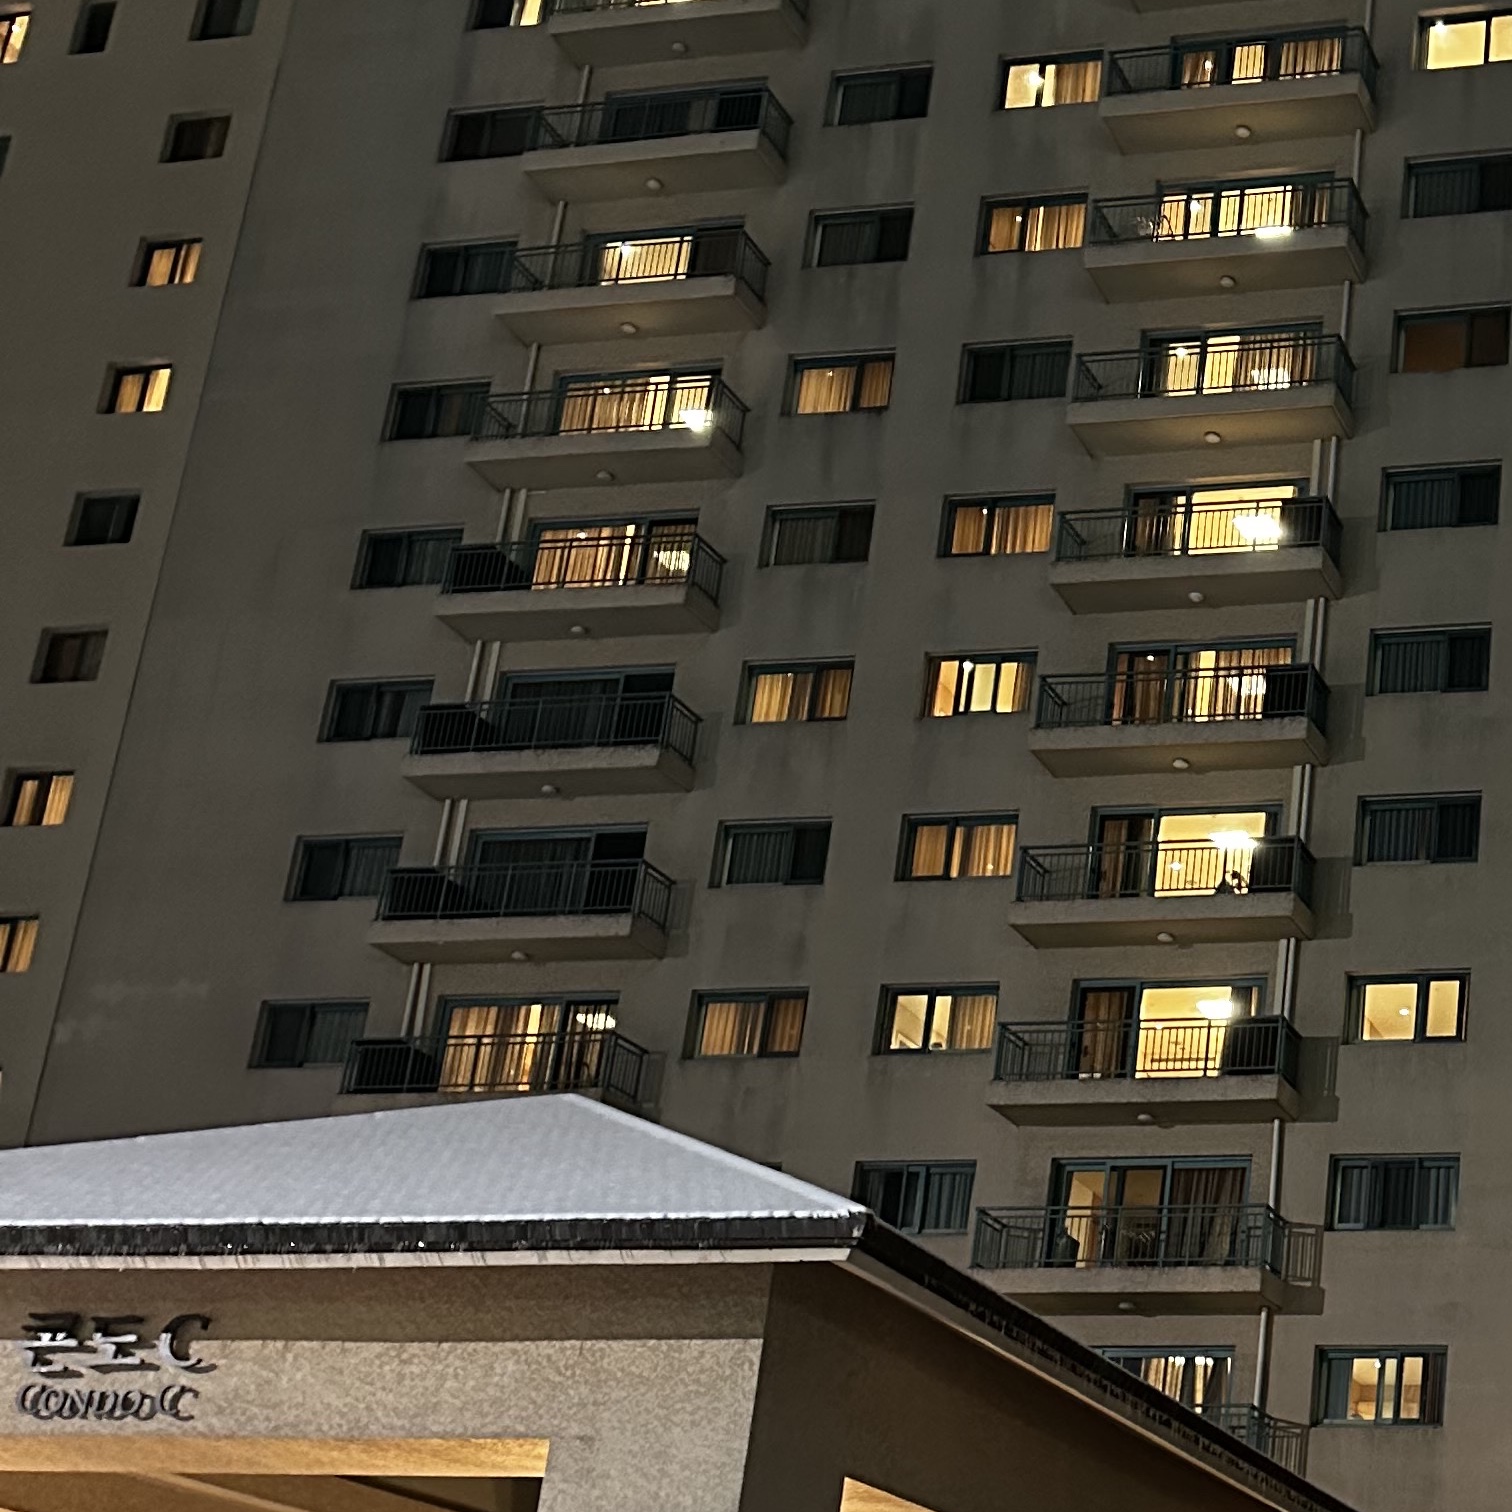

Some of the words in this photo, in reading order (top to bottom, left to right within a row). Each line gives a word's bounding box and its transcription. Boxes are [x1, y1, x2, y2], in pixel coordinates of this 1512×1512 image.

[21, 1312, 146, 1373] 콘도
[157, 1313, 212, 1368] C
[157, 1384, 200, 1419] C
